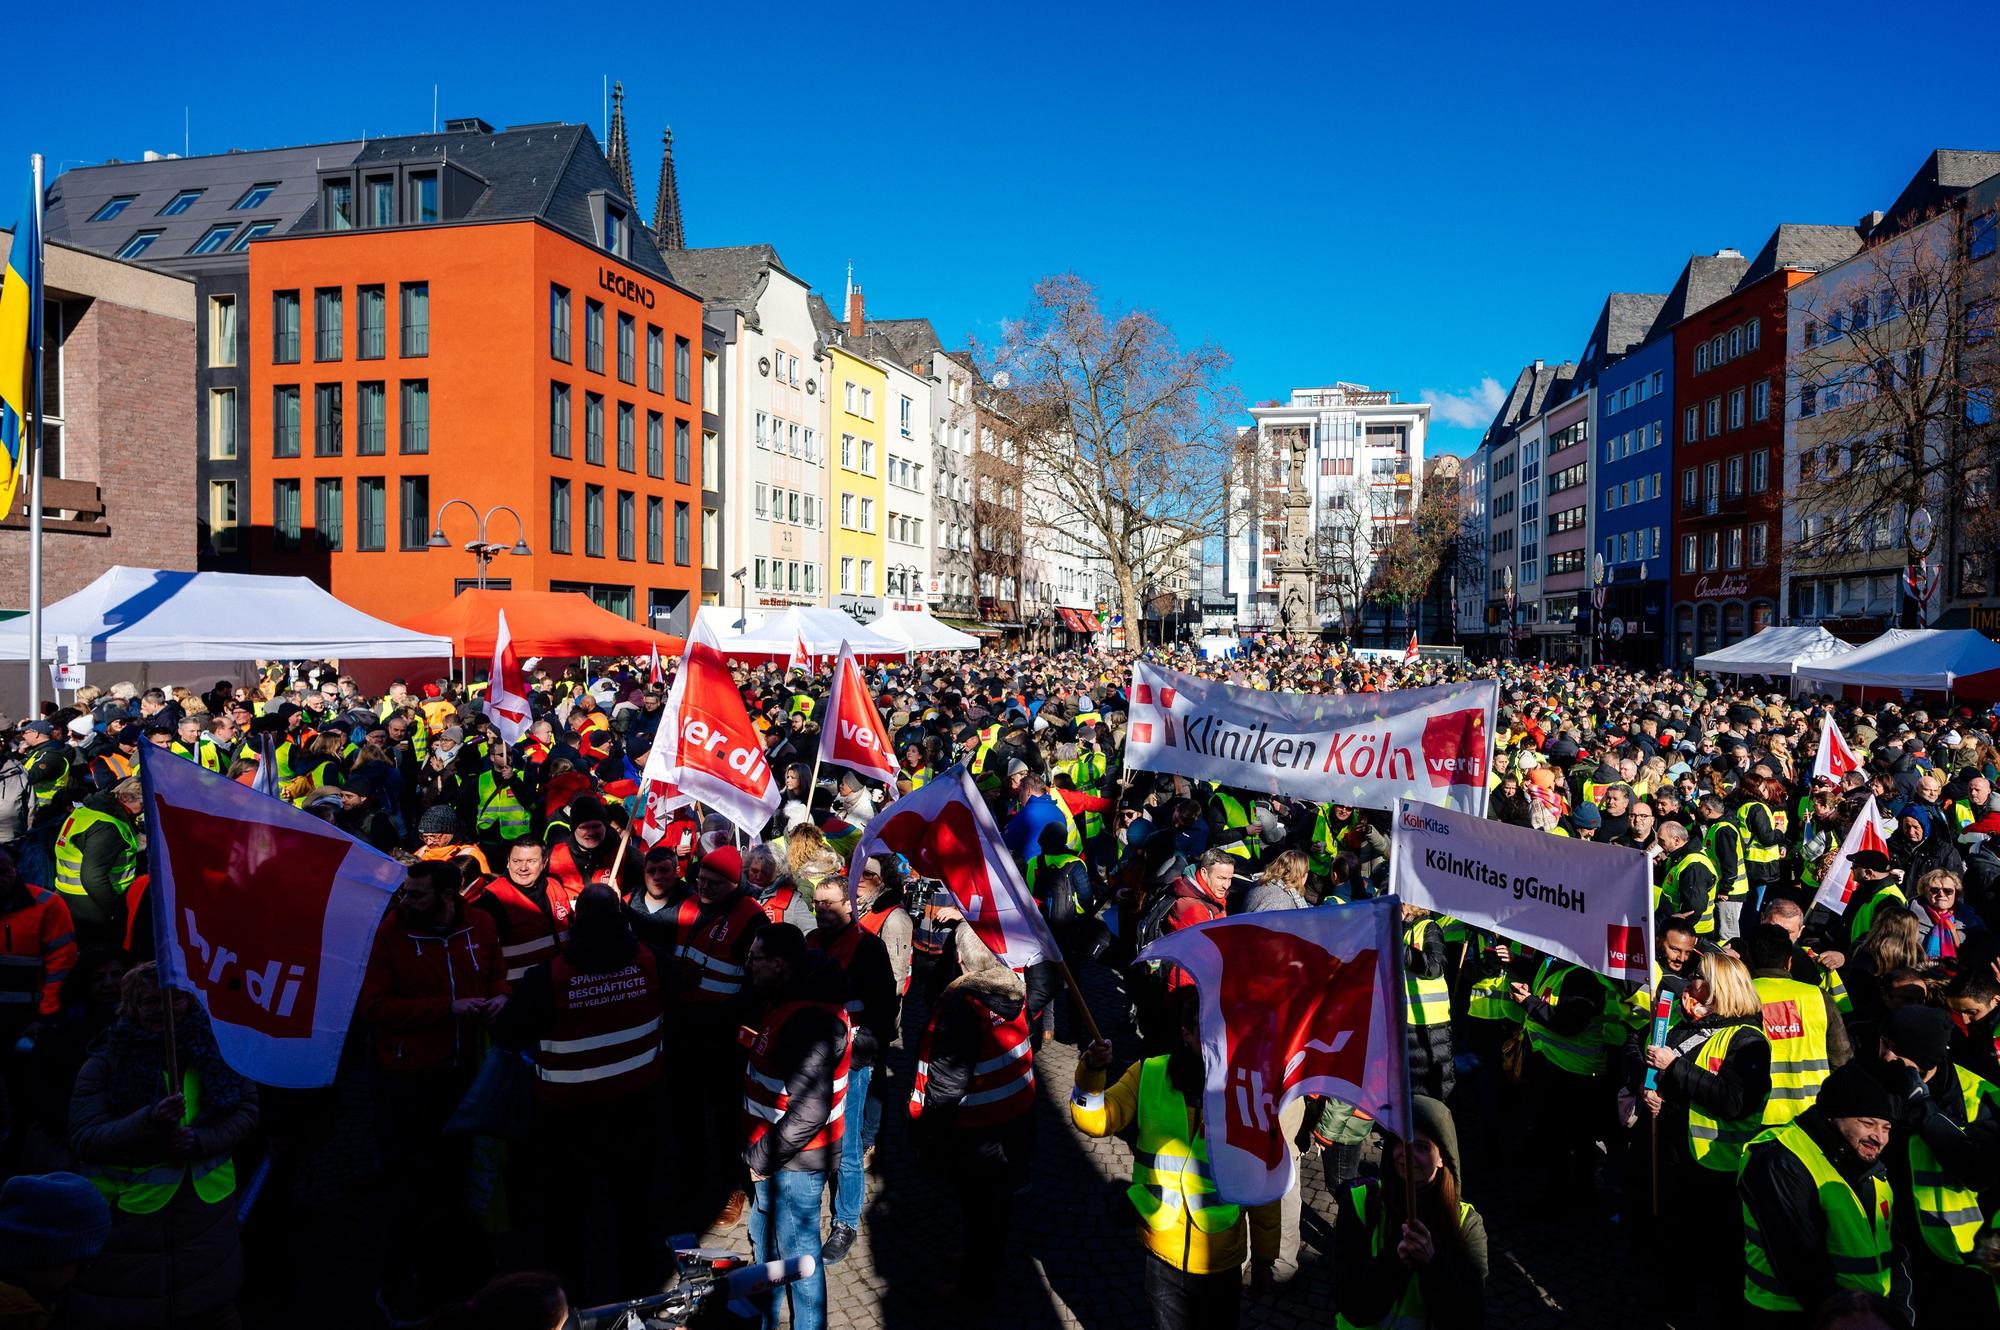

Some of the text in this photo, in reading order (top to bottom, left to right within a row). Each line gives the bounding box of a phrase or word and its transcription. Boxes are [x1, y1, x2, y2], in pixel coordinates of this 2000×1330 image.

[599, 266, 655, 310] LEGEND
[1694, 575, 1747, 598] Chocolaterie
[1182, 714, 1416, 781] Kliniken Köln
[1403, 811, 1450, 837] KölnKitas
[1425, 848, 1586, 914] KölnKitas gGmbH
[568, 976, 646, 1001] BESCHÄFTIGTE
[1766, 1023, 1801, 1034] ver.di
